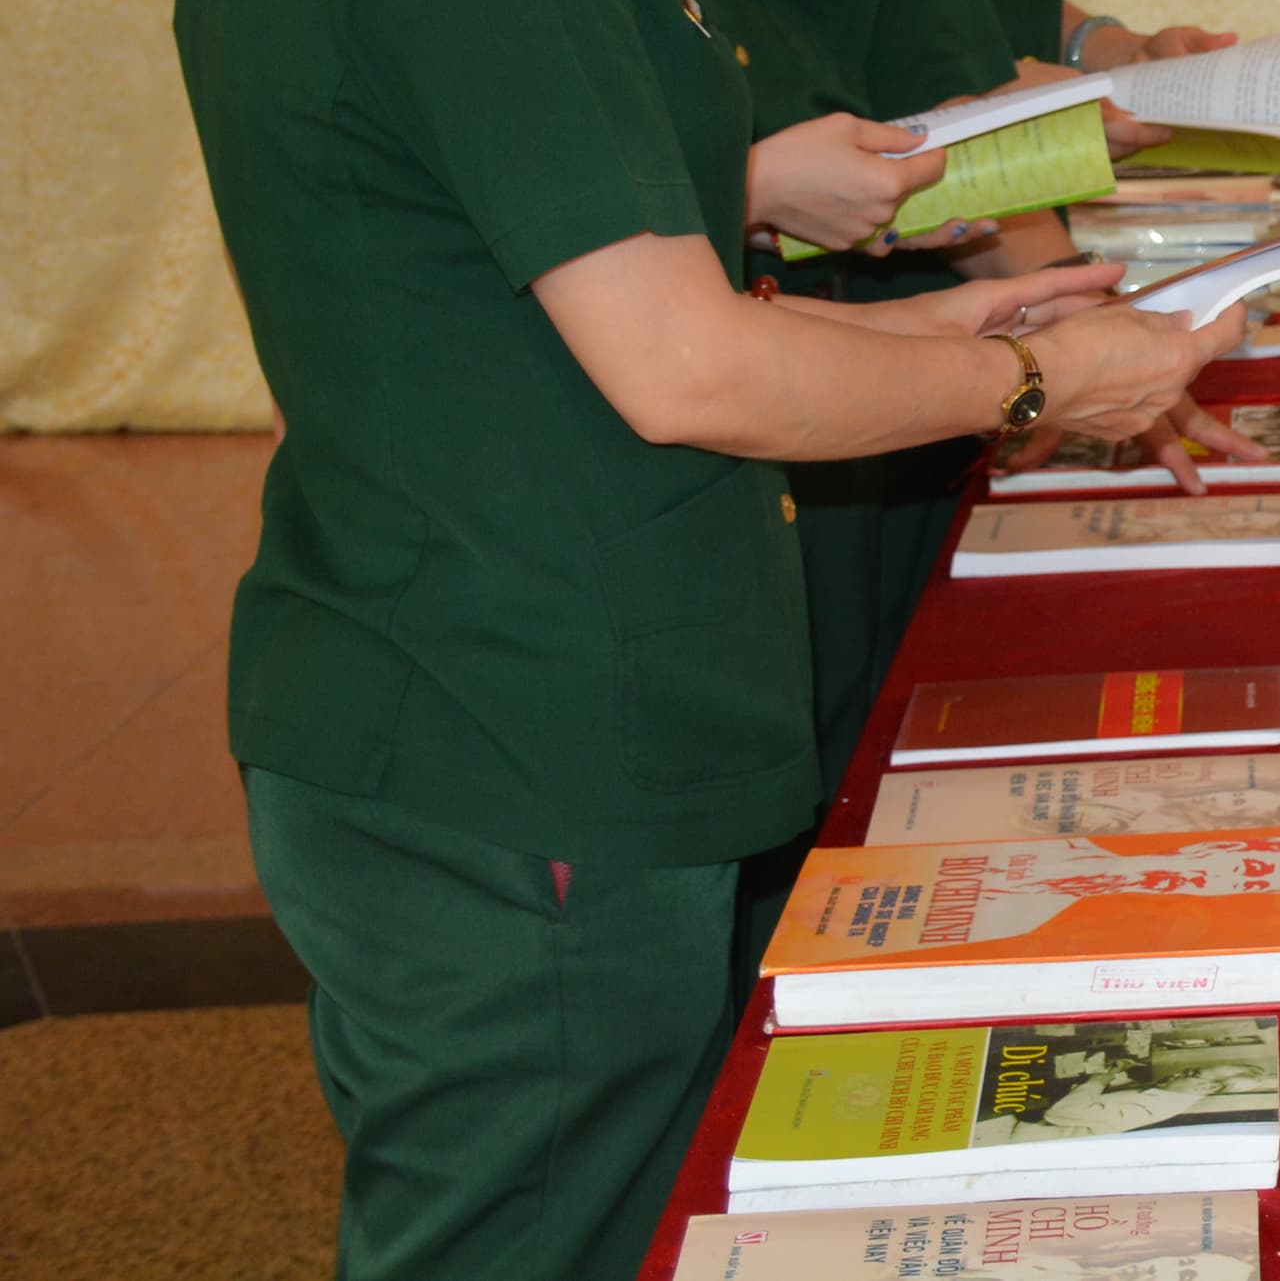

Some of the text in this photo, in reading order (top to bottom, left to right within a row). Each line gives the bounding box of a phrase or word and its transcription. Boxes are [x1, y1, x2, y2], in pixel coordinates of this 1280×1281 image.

[919, 856, 1006, 944] HỒ CHÍ MINH
[993, 1045, 1048, 1114] Di chúc
[879, 1126, 900, 1150] MINH
[864, 1219, 897, 1263] HIỆN NAY
[933, 1213, 970, 1277] VỀ QUÂN ĐỘI
[982, 1209, 1024, 1265] MINH
[1029, 1207, 1075, 1240] CHÍ
[1073, 1204, 1128, 1230] HỒ
[895, 1216, 935, 1277] VÀ VIỆC VẬN
